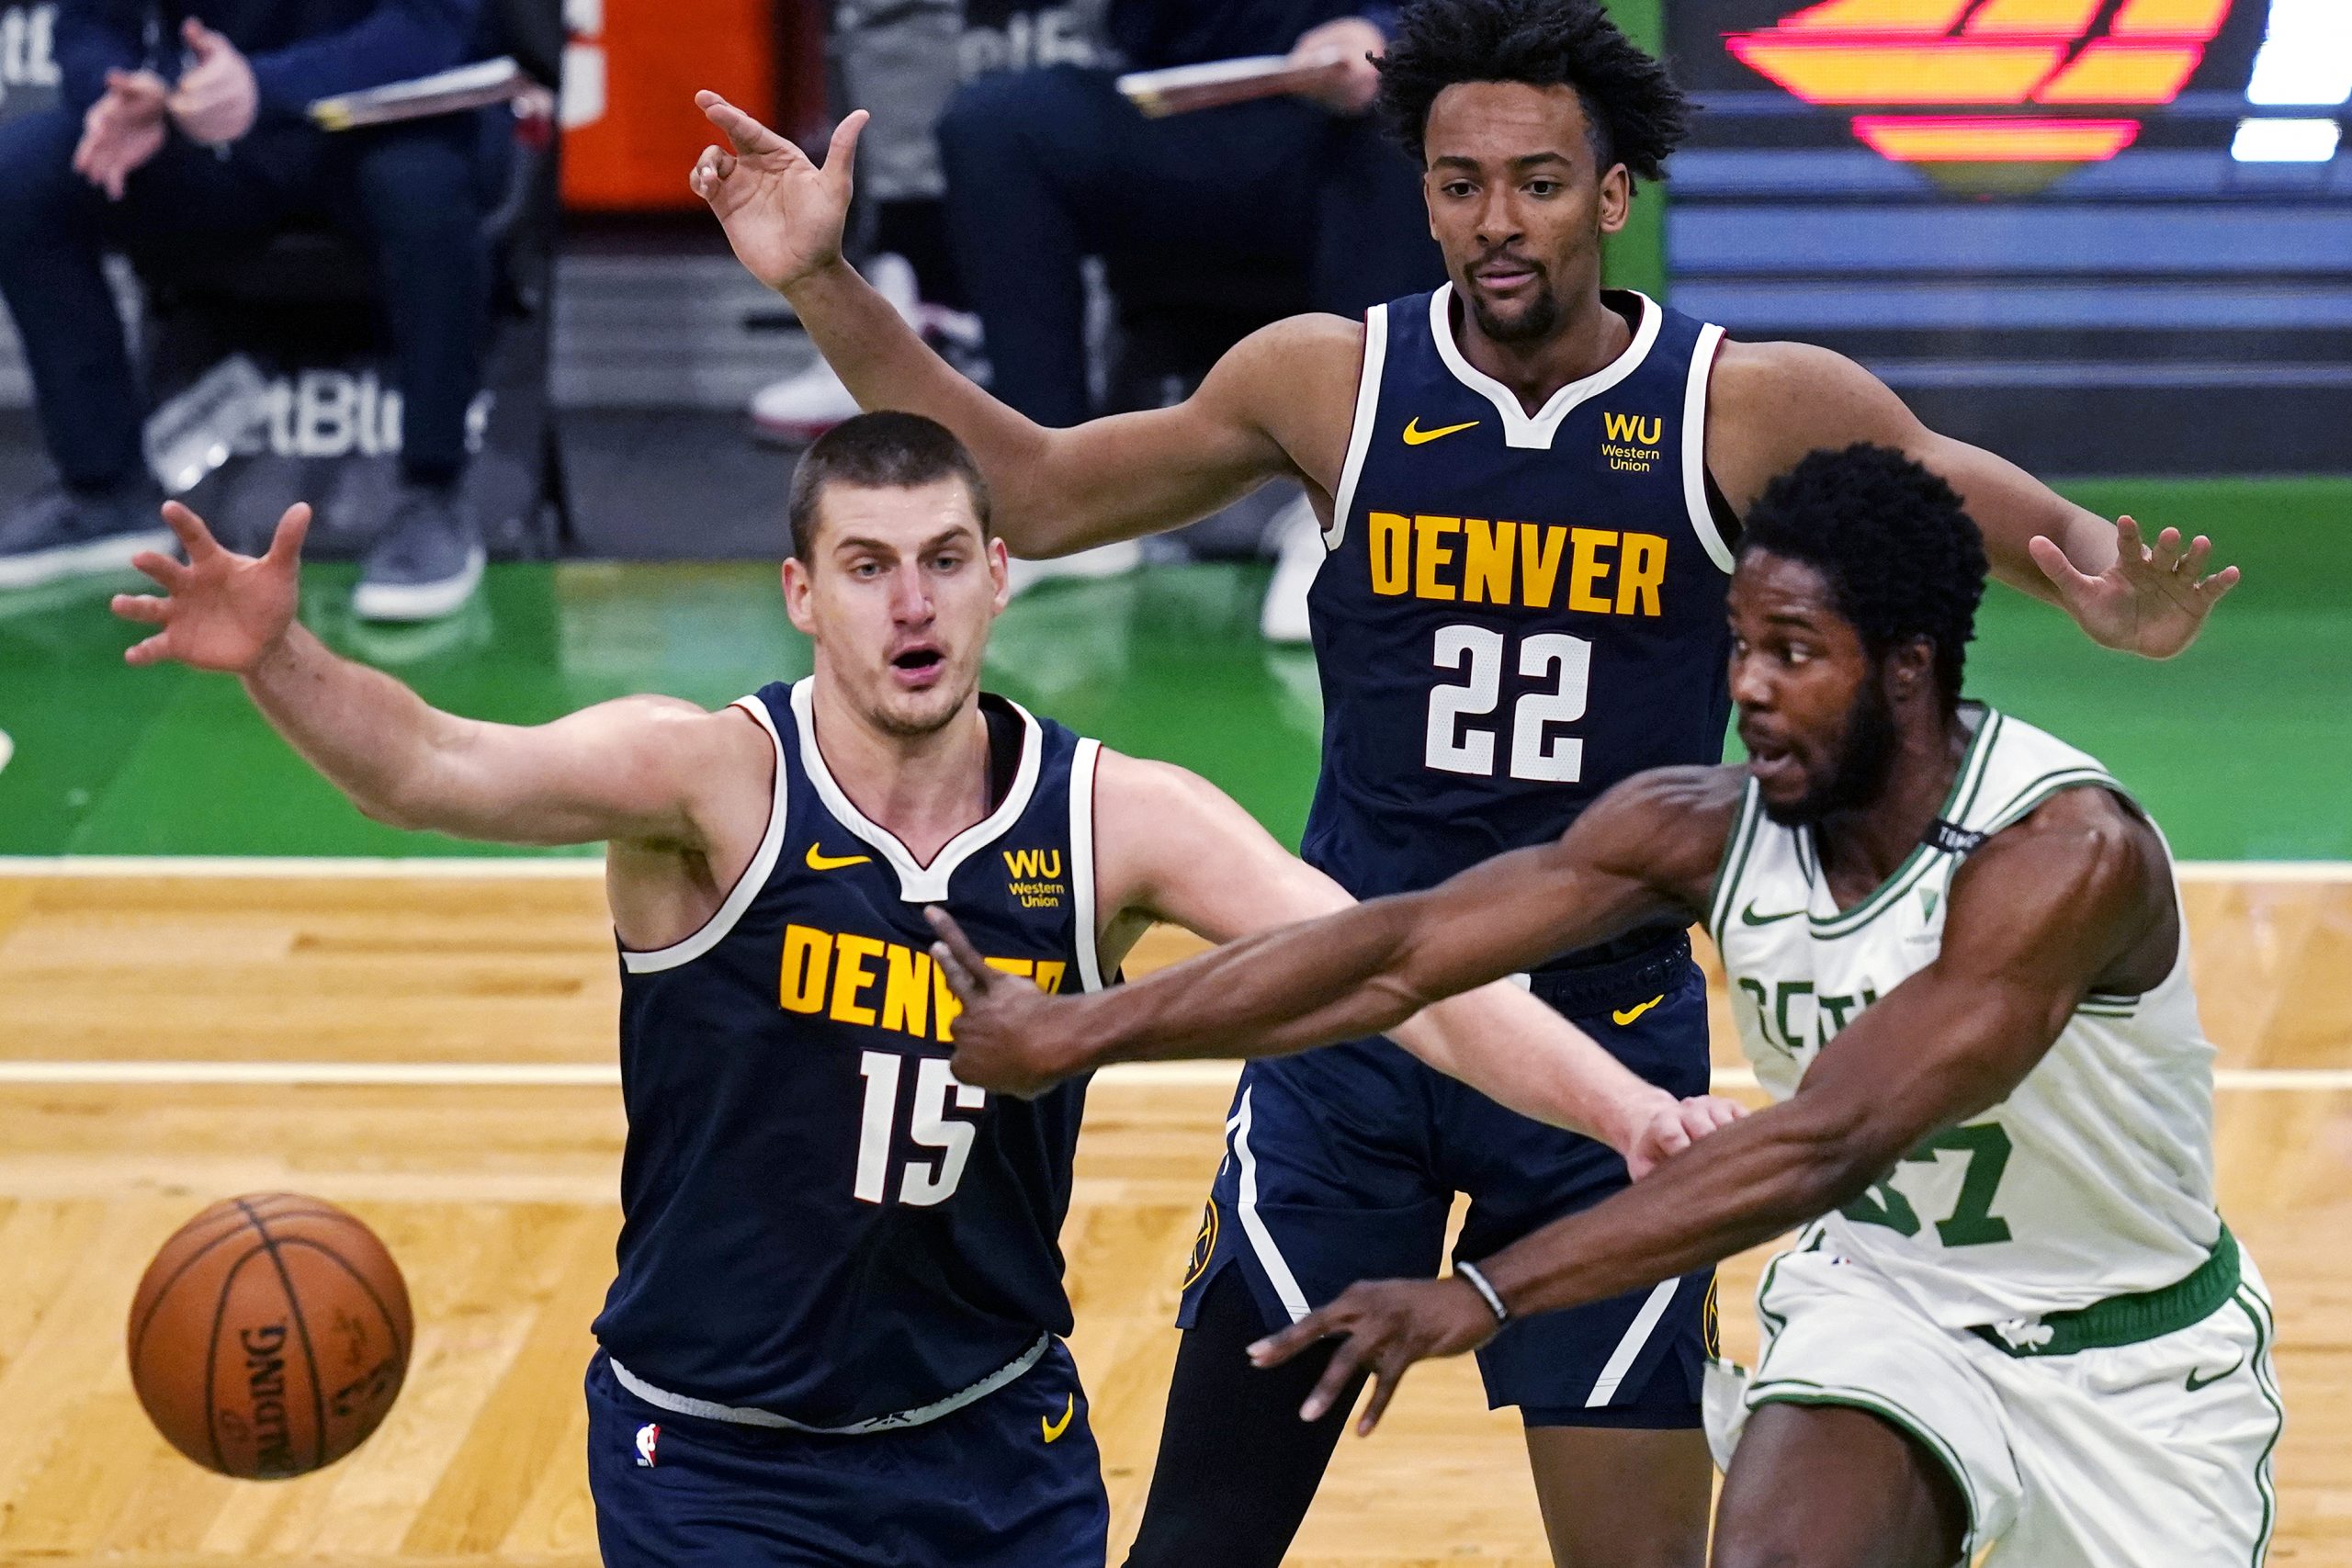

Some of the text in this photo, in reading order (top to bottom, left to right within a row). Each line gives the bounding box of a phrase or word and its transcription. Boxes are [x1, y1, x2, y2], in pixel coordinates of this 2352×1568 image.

[1603, 412, 1662, 446] WU
[1601, 443, 1660, 460] Western
[1610, 457, 1650, 472] Union
[1369, 512, 1668, 616] DENVER
[1425, 624, 1593, 783] 22
[1002, 848, 1061, 879] WU
[1008, 881, 1065, 896] Western
[1021, 894, 1059, 908] Union
[780, 923, 1067, 1043] DENV
[854, 1050, 986, 1206] 15
